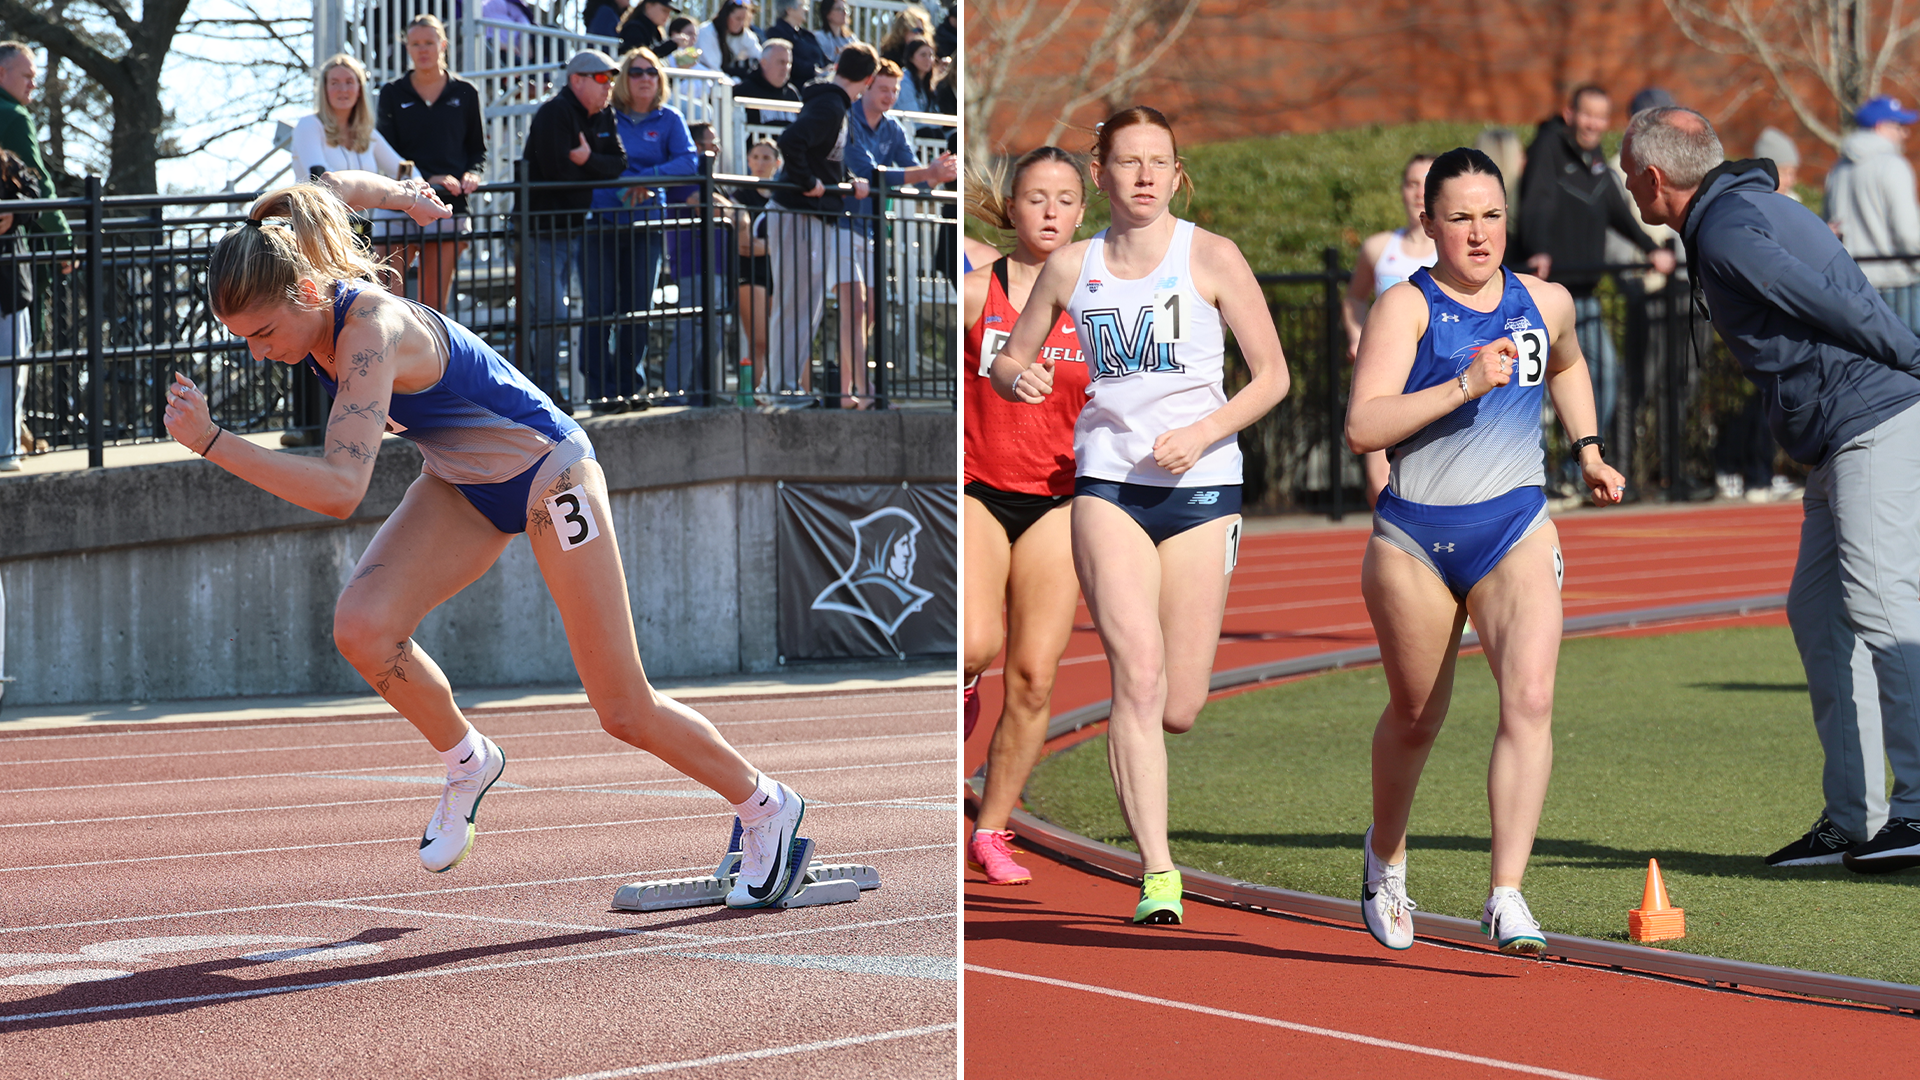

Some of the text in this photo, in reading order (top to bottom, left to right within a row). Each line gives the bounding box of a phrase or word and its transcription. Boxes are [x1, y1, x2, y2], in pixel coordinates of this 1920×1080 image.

[1163, 294, 1180, 340] 1
[1041, 346, 1086, 362] IELD
[1082, 305, 1185, 382] M
[1521, 332, 1542, 383] 3
[554, 493, 589, 545] 3
[1231, 523, 1238, 568] 1
[1818, 827, 1849, 850] N
